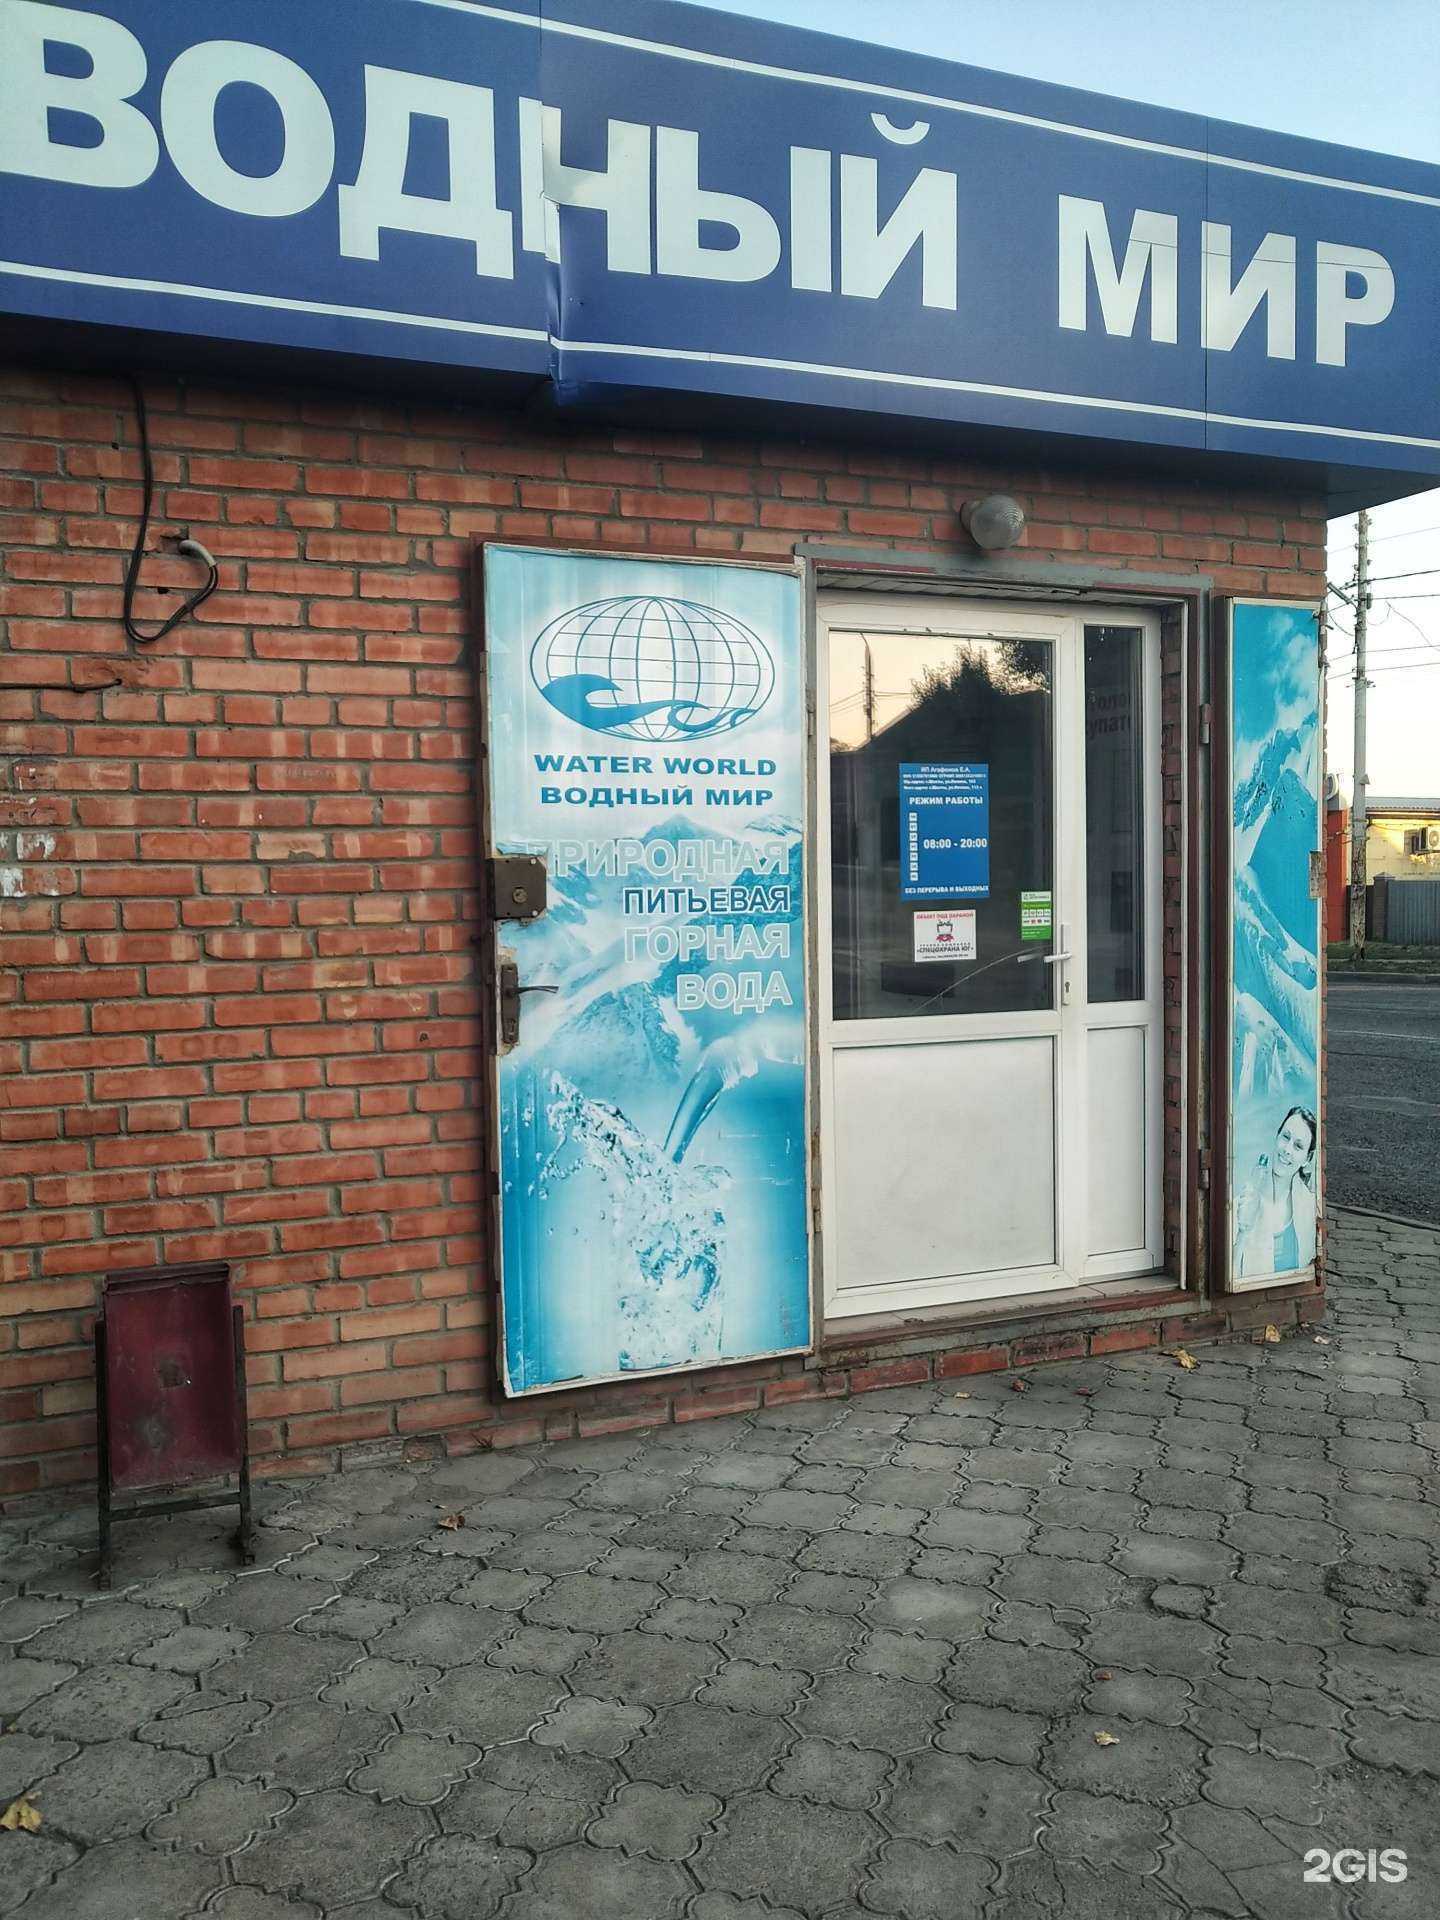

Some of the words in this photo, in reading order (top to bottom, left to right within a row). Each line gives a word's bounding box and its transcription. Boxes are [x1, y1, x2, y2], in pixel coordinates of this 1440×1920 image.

[0, 0, 957, 311] ВОДНЫЙ
[1058, 193, 1396, 367] МИР
[533, 754, 654, 774] WATER
[663, 757, 777, 776] WORLD
[541, 785, 693, 807] ВОДНЫЙ
[705, 788, 774, 806] МИР
[909, 796, 943, 805] РЕЖИМ
[945, 796, 983, 805] РАБОТЫ
[923, 838, 952, 849] 08:00
[960, 838, 988, 849] 20:00
[623, 885, 790, 915] ПИТЬЕВАЯ
[955, 885, 989, 893] ВЫХОДНЫХ
[624, 923, 790, 962] ГОРНАЯ
[676, 970, 792, 1014] ВОДА
